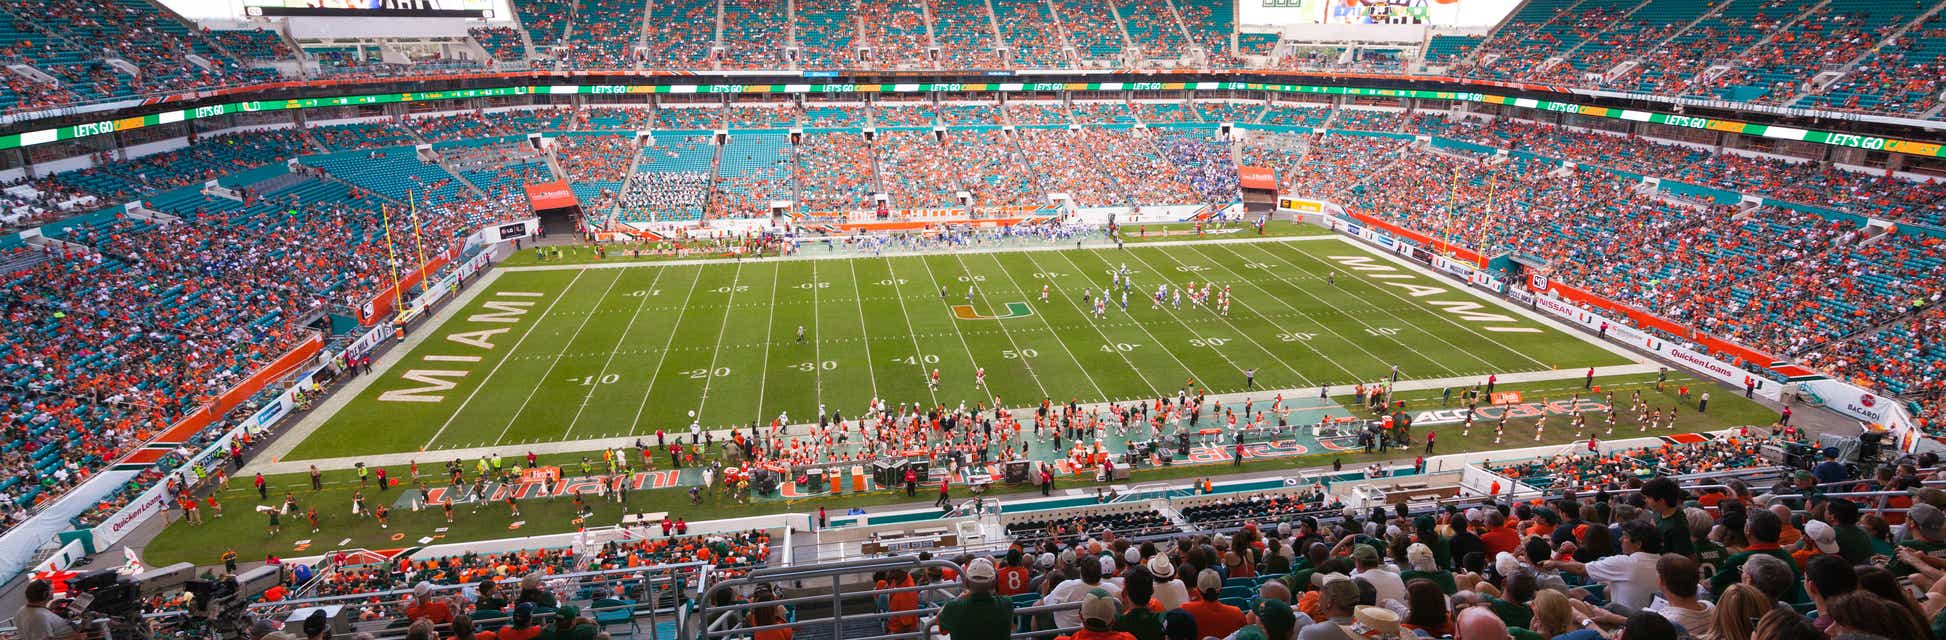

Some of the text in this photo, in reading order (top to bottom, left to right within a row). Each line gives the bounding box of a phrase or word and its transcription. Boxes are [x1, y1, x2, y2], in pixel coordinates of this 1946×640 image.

[592, 85, 612, 93] LET'S
[613, 85, 626, 93] GO
[710, 84, 730, 93] LET'S
[730, 84, 742, 93] GO
[823, 84, 841, 92] LET'S
[841, 84, 854, 92] GO
[931, 84, 949, 92] LET'S
[950, 84, 961, 92] GO
[1034, 83, 1052, 91] LET'S
[1052, 83, 1063, 91] GO
[1133, 82, 1150, 90] LET'S
[1150, 82, 1161, 90] GO
[196, 104, 223, 119] LET'S GO
[1547, 102, 1566, 112] LET'S
[1567, 103, 1578, 113] GO
[1664, 115, 1690, 127] LET'S
[1690, 117, 1706, 128] GO
[74, 121, 99, 138] LET'S
[99, 120, 114, 134] GO
[1824, 132, 1861, 147] LET'S
[1862, 137, 1884, 150] GO
[1326, 255, 1545, 334] MIAMI
[1539, 297, 1573, 317] NISSAN
[1276, 331, 1315, 343] 20
[1365, 327, 1400, 337] 10
[377, 291, 544, 403] MIAMI
[1100, 342, 1135, 353] 40
[1188, 337, 1226, 348] 30
[904, 354, 941, 366] 40
[1002, 348, 1039, 360] 50
[799, 360, 838, 372] 30
[1671, 348, 1732, 377] Quicken Loans
[689, 366, 732, 379] 20
[579, 373, 621, 386] 10
[1413, 408, 1479, 425] ACC
[112, 493, 163, 533] Quicken Loans
[1008, 570, 1021, 590] 8
